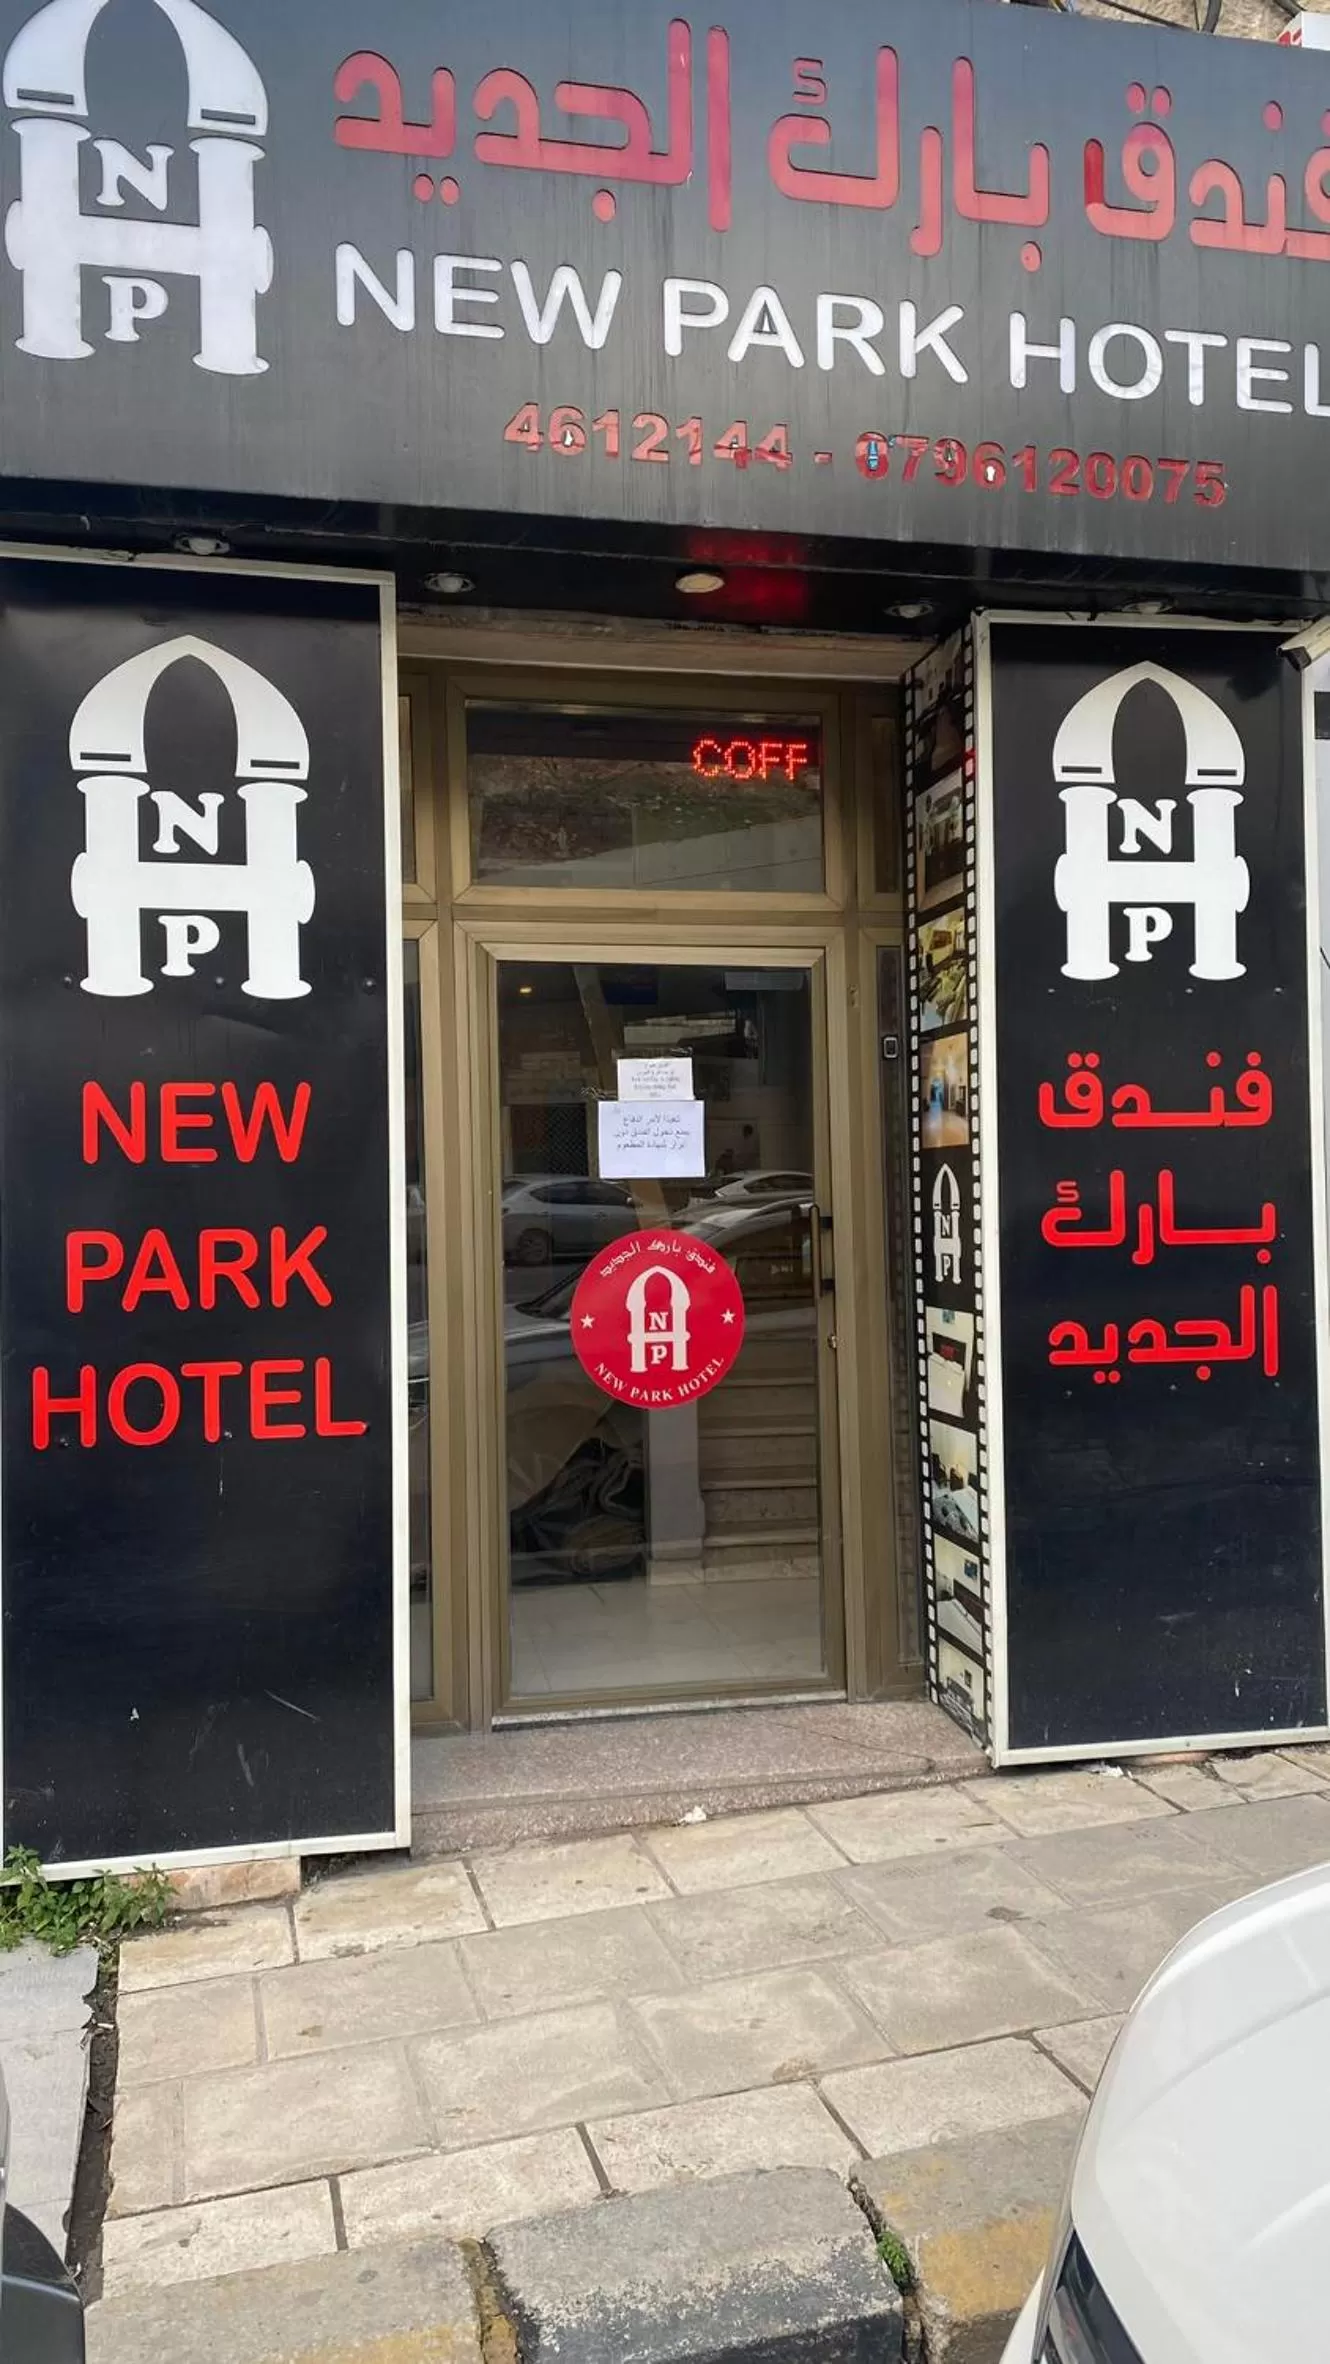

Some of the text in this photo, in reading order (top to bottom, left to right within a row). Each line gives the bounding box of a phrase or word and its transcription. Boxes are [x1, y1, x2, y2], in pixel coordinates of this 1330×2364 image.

[333, 18, 731, 232] الجديد
[768, 46, 1050, 272] بارك
[335, 242, 1330, 416] NEW PARK HOTEL
[504, 402, 793, 472] 4612144
[855, 430, 1227, 508] 0796120075
[693, 739, 807, 781] COFF
[83, 1081, 311, 1164] NEW
[1039, 1051, 1273, 1128] فندق
[1041, 1169, 1276, 1264] بارك
[66, 1226, 331, 1313] PARK
[594, 1357, 725, 1402] NEW PARK HOTEL
[1048, 1285, 1279, 1384] الجديد
[33, 1357, 368, 1450] HOTEL
